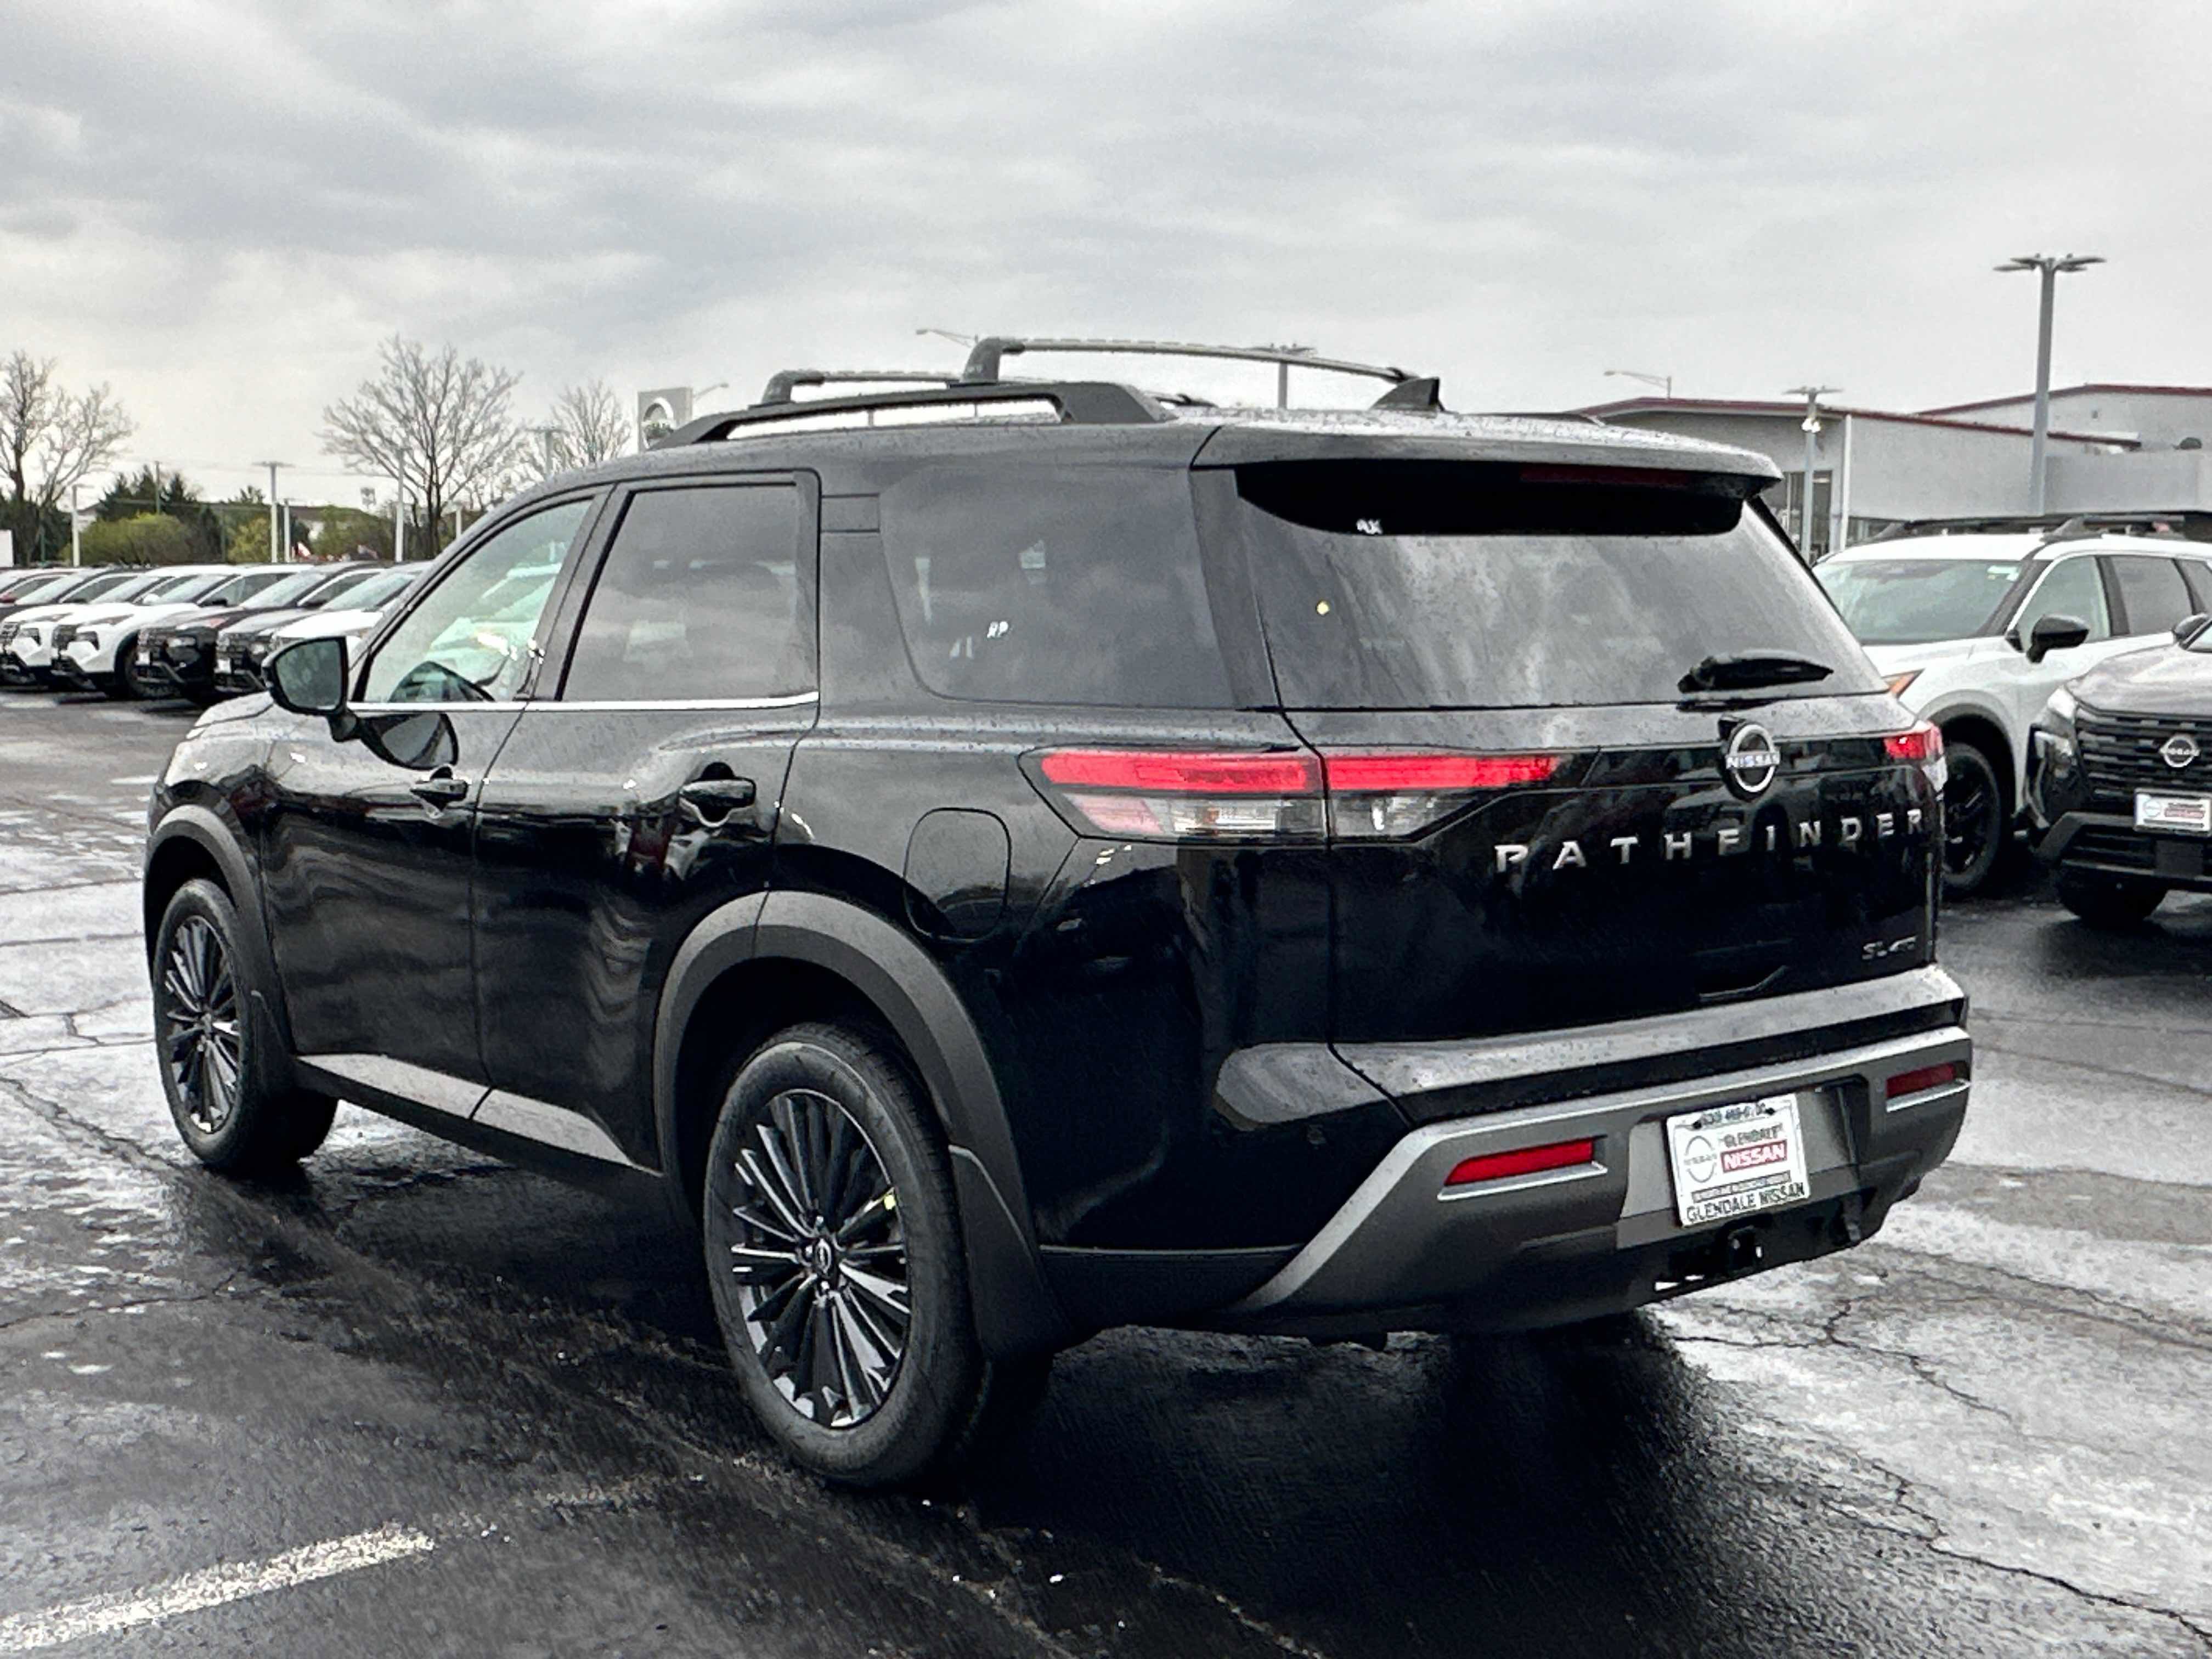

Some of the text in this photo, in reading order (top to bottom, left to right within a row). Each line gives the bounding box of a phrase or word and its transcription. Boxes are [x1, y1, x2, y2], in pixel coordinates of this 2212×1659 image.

[1726, 752, 1780, 769] NISSAN
[1494, 809, 1922, 873] PATHFINDER
[1724, 1143, 1786, 1169] NISSAN
[1686, 1194, 1755, 1222] GLENDALE
[1759, 1182, 1804, 1205] NISSAN
